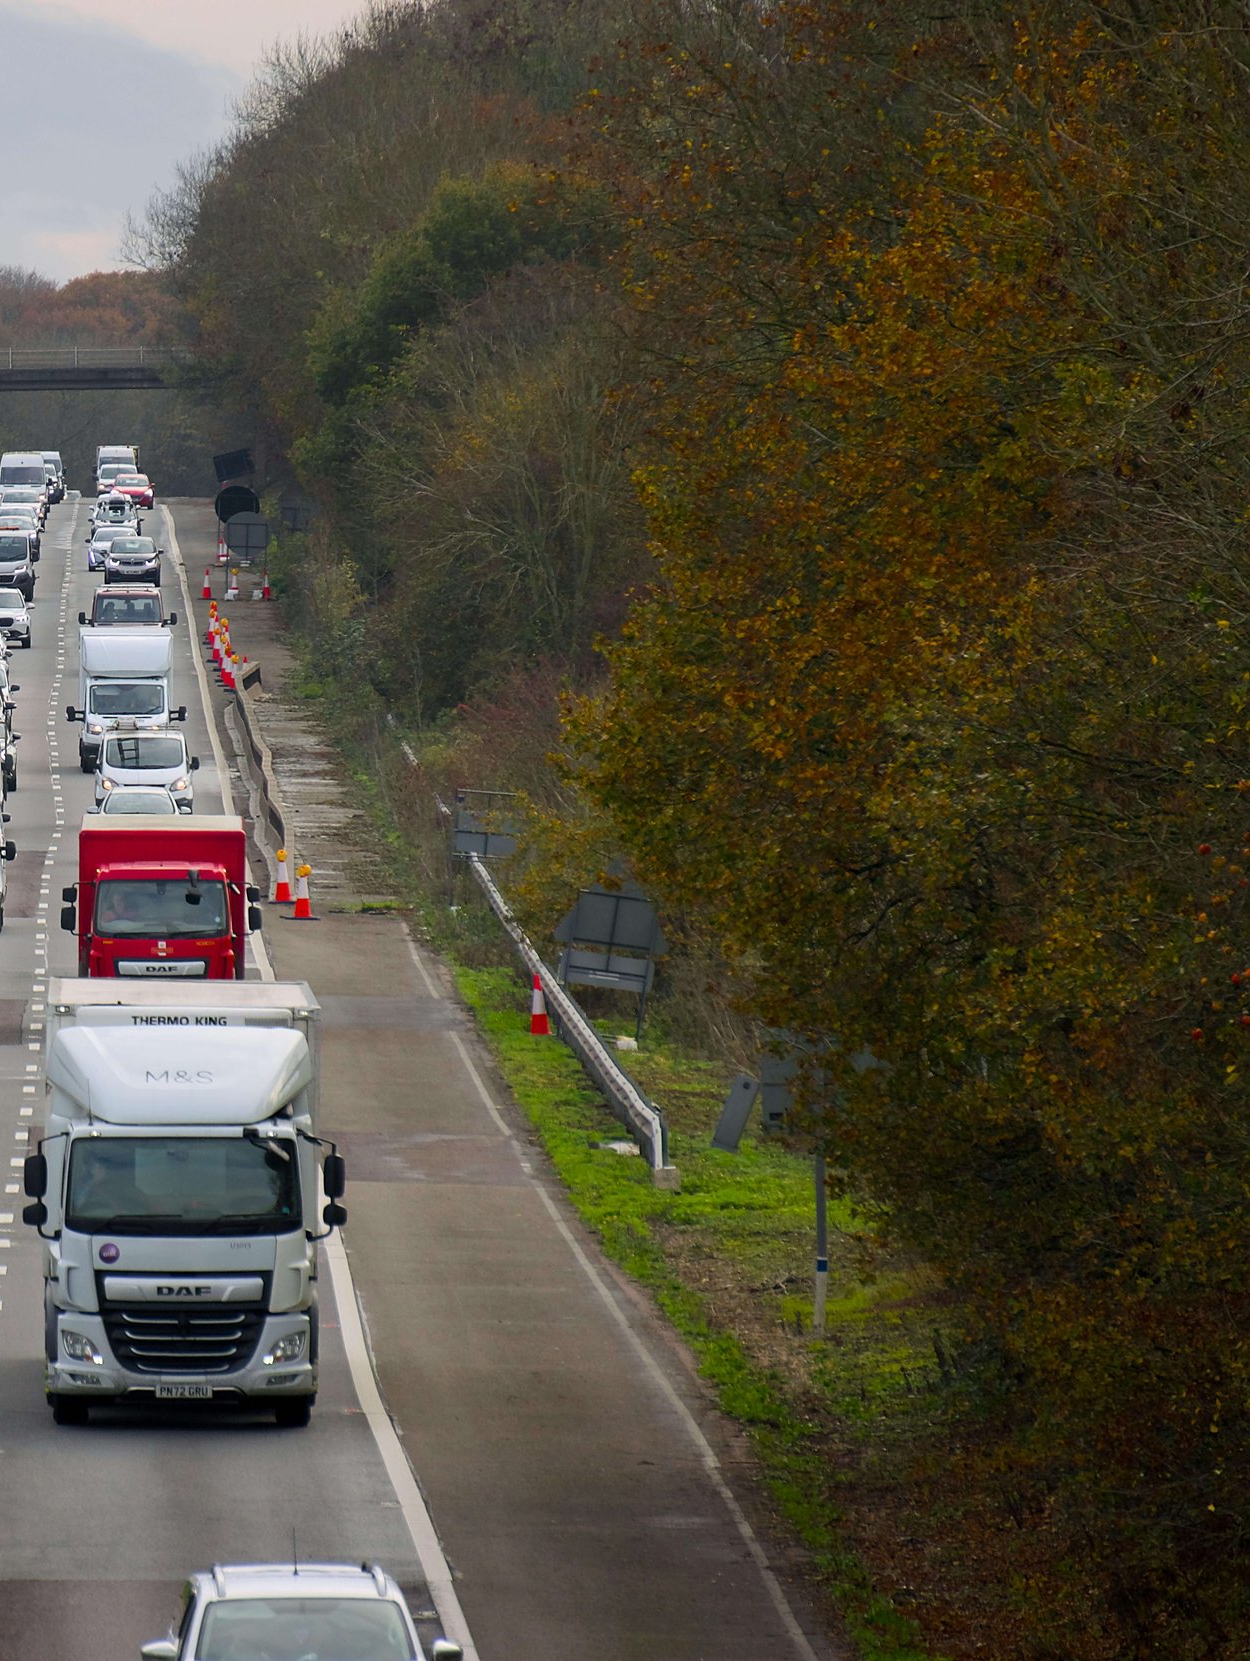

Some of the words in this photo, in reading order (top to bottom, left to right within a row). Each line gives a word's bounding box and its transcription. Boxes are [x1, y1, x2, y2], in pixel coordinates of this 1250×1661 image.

[132, 1016, 189, 1026] THERMO
[196, 1016, 227, 1026] KING
[146, 1070, 213, 1084] M&S
[156, 1286, 211, 1296] DAF
[160, 1386, 186, 1397] PN72
[188, 1386, 208, 1397] GRU
